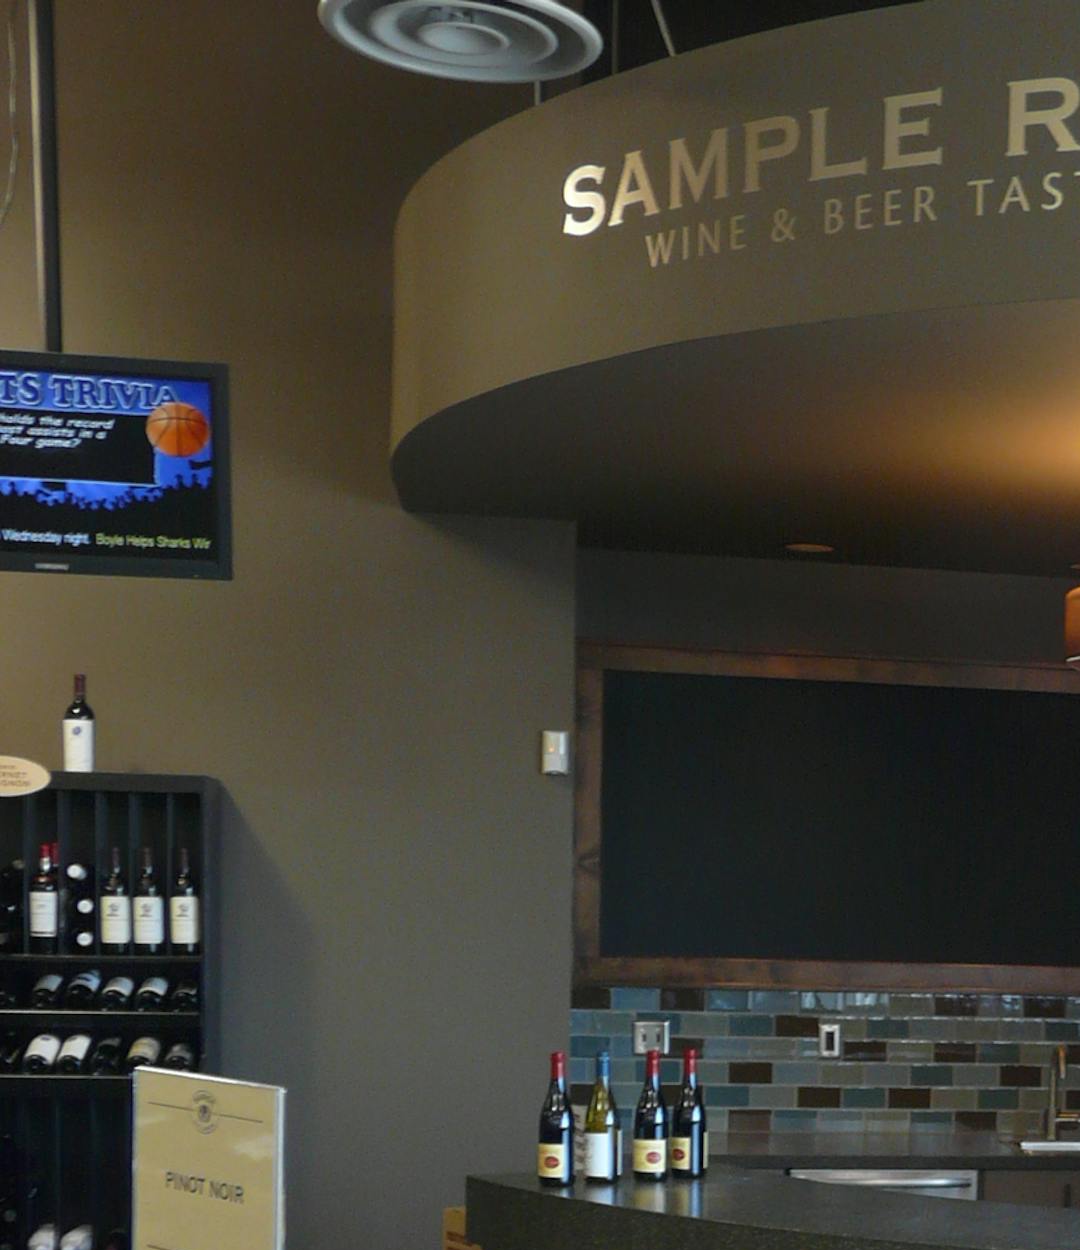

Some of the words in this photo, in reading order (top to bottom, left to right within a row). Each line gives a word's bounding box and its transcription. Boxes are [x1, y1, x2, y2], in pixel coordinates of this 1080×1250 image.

[563, 87, 943, 237] SAMPLE
[644, 214, 748, 268] WINE
[770, 207, 797, 243] &
[823, 186, 938, 235] BEER
[50, 374, 179, 409] TRIVIA
[165, 1171, 206, 1196] PINOT
[209, 1179, 245, 1205] NOIR
